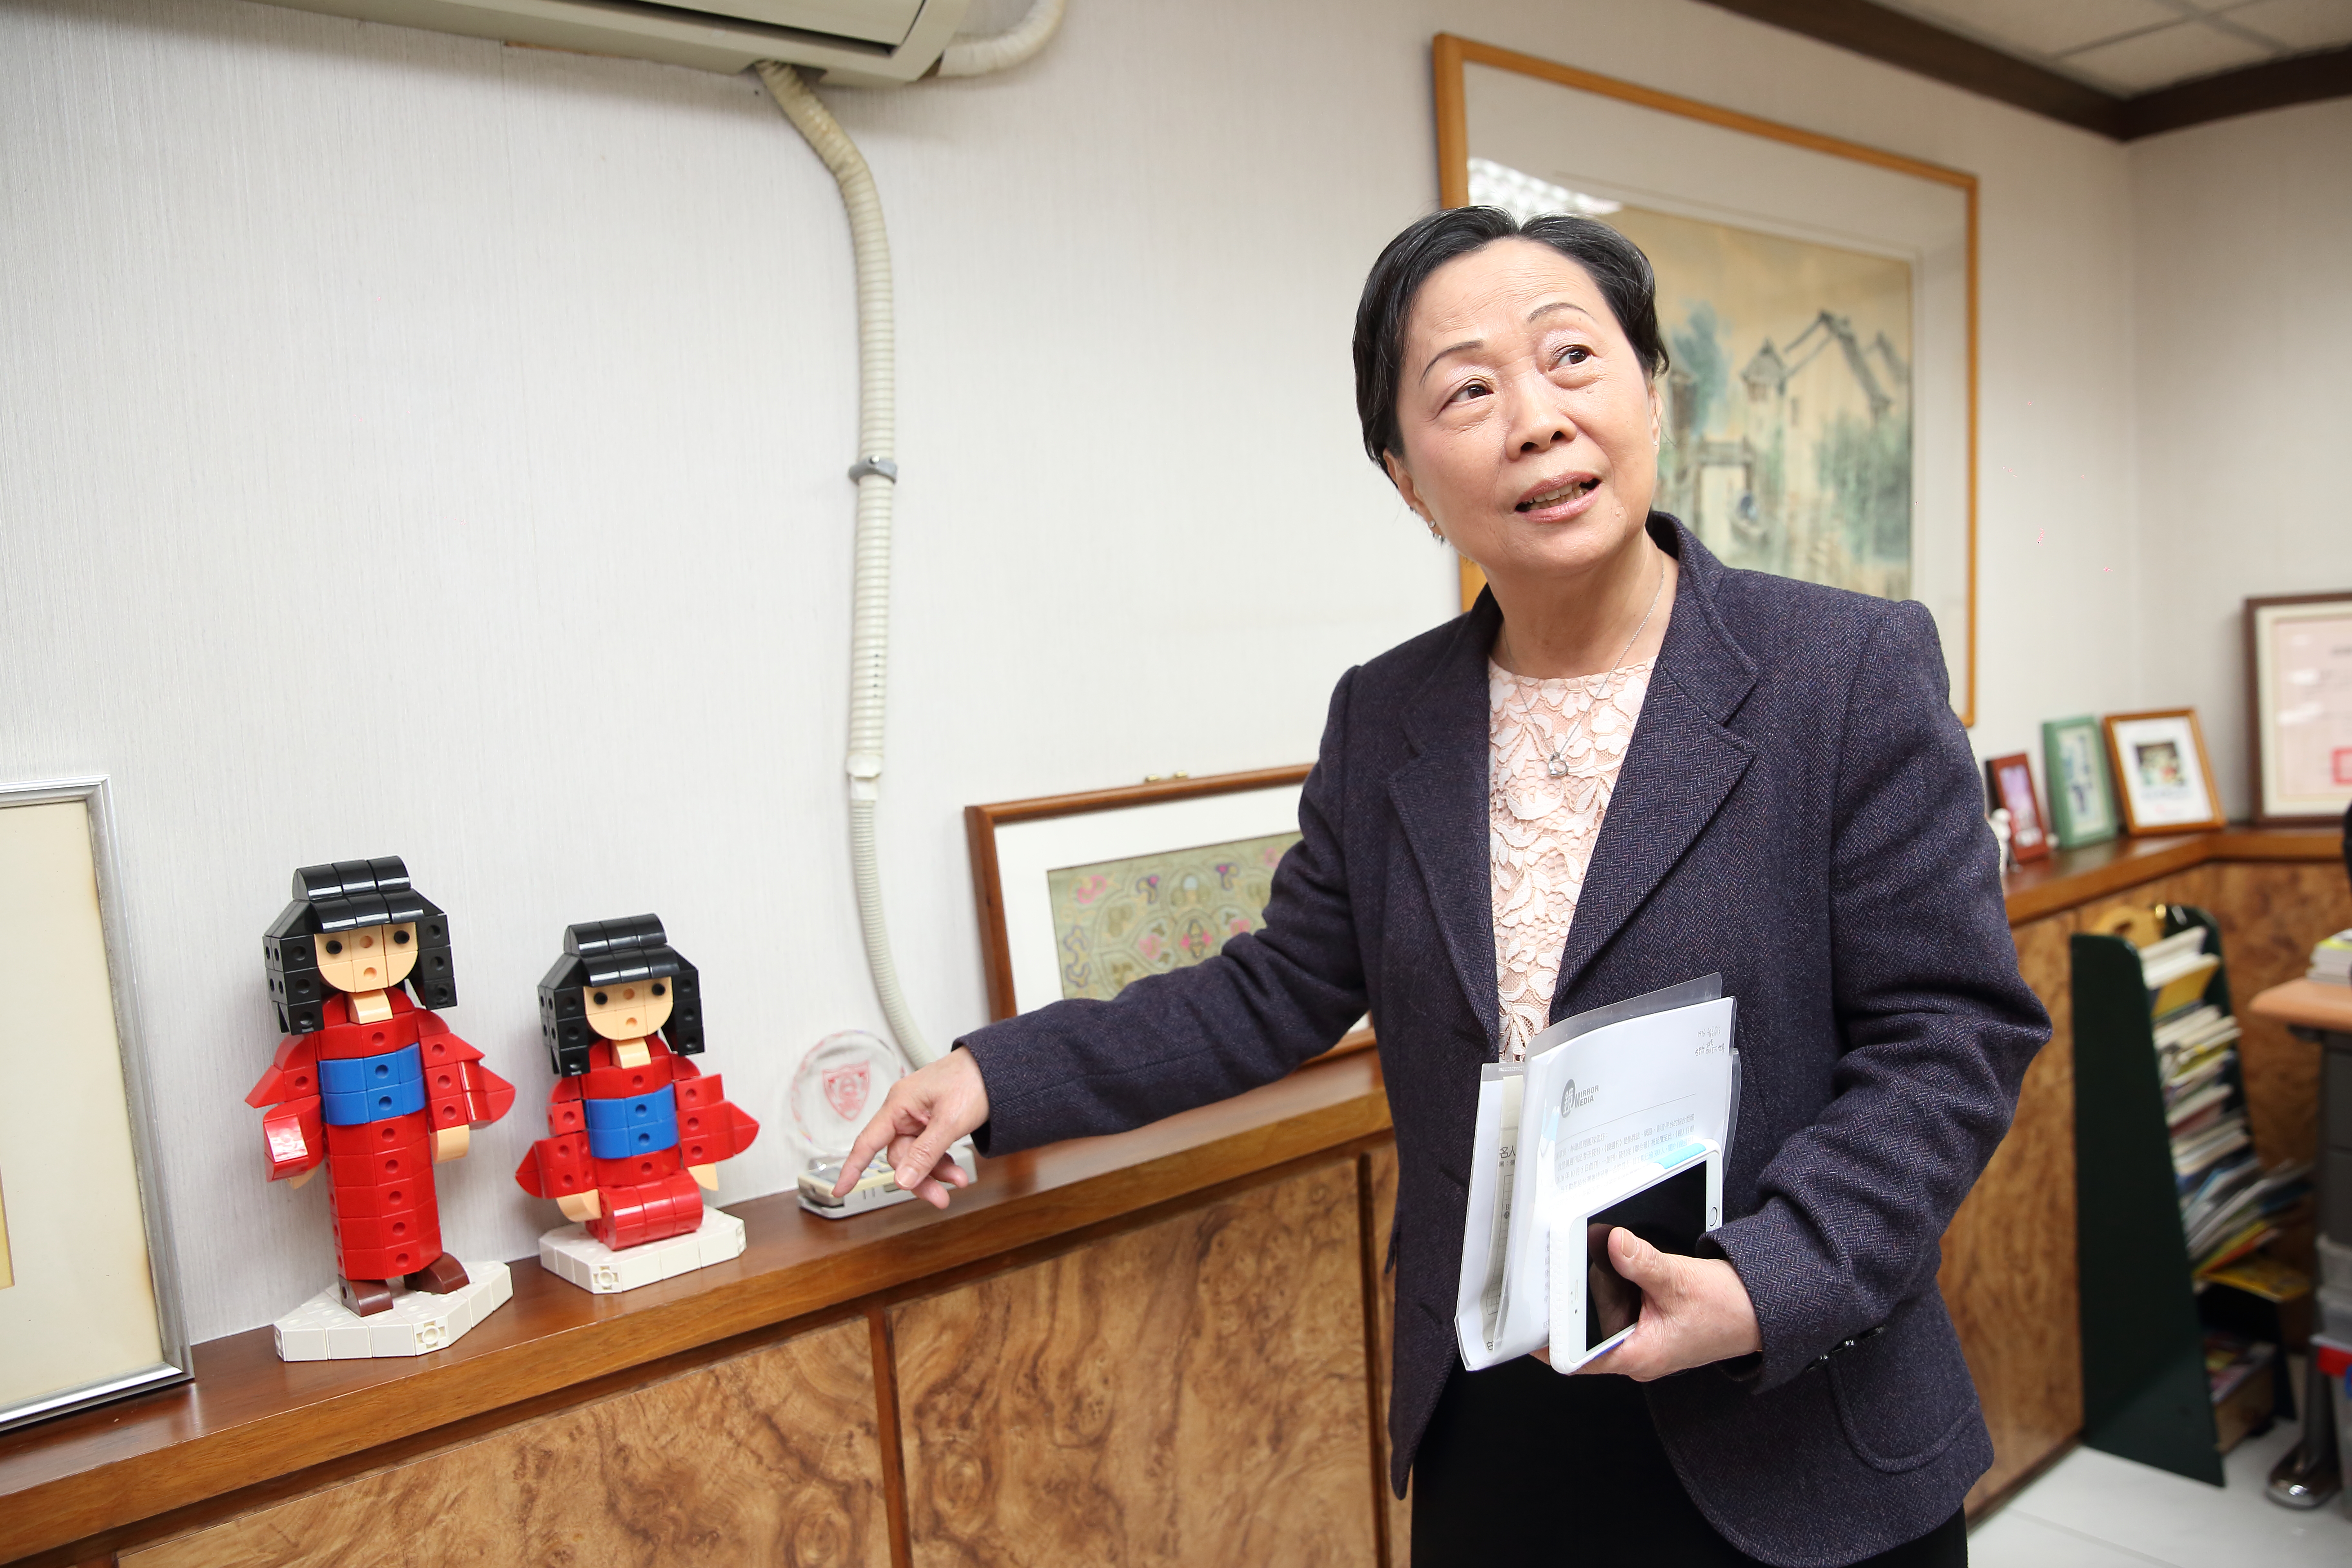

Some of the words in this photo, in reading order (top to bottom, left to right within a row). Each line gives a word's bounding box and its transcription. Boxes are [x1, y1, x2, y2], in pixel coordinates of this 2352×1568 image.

[1575, 1085, 1599, 1108] MIRROR
[1575, 1093, 1594, 1109] MEDIA
[1499, 1145, 1516, 1158] 名人
